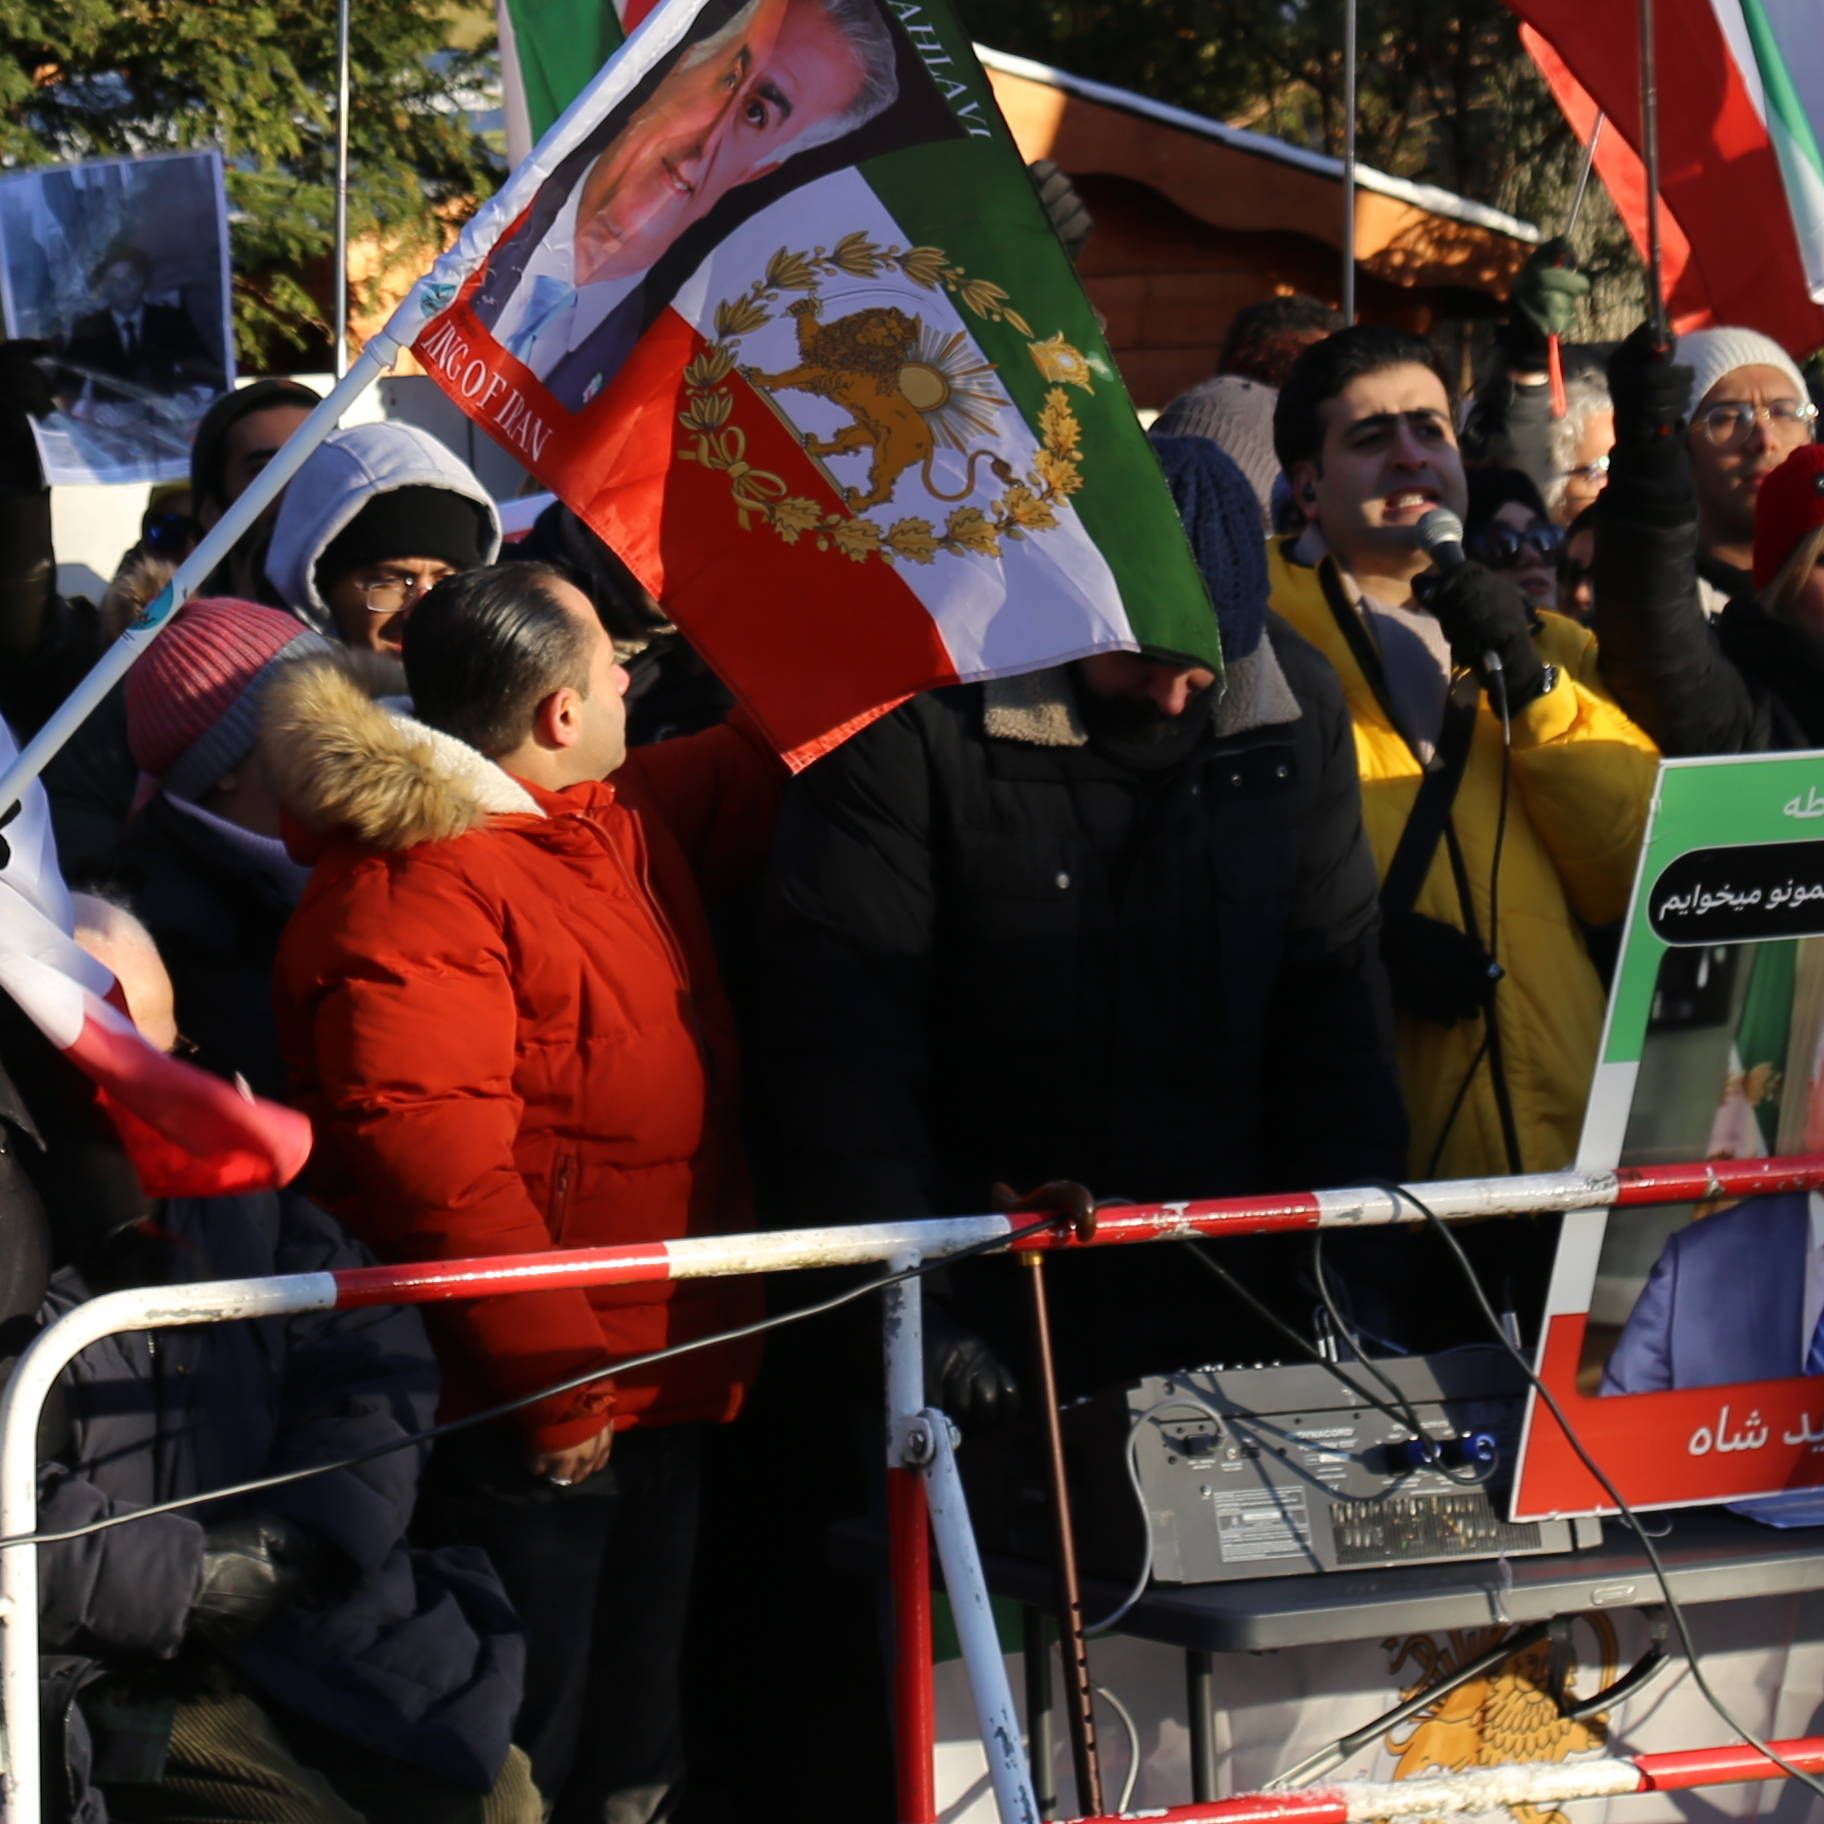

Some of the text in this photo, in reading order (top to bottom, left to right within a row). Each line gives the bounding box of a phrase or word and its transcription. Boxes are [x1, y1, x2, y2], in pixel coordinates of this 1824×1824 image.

[421, 319, 553, 463] ING OF IRAN
[1658, 883, 1763, 921] میخوایم
[1688, 1404, 1770, 1457] شاه
